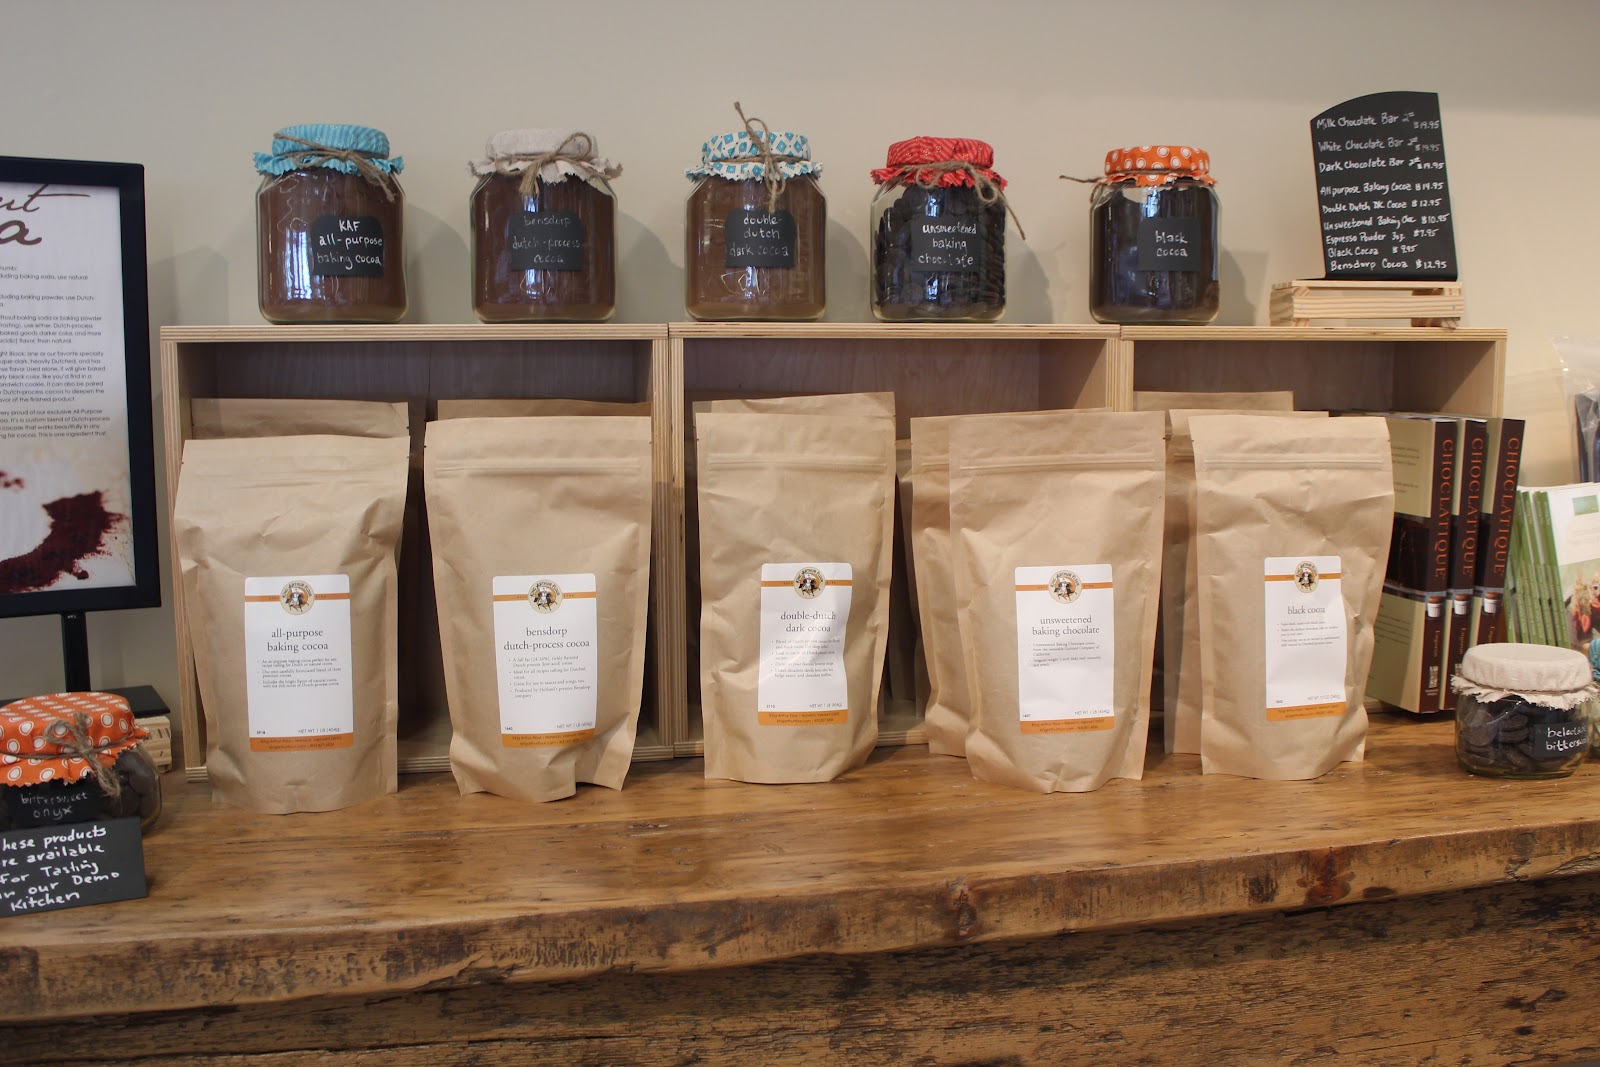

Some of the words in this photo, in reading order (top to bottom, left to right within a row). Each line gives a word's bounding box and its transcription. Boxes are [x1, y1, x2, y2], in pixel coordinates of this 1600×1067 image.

[1316, 118, 1336, 129] Milk
[1338, 115, 1377, 127] Chocolate
[1381, 112, 1399, 125] Bar
[1318, 141, 1342, 152] White
[1345, 138, 1385, 150] Chocolate
[1387, 137, 1403, 148] Bar
[1318, 161, 1343, 173] Dark
[1344, 157, 1386, 169] Chocolate
[1389, 157, 1404, 167] Bar
[1363, 182, 1389, 195] Baking
[1391, 182, 1412, 191] Cocoa
[1322, 203, 1347, 214] Double
[1349, 200, 1371, 211] Dutch
[1387, 200, 1407, 209] Cocoa
[339, 219, 360, 232] KAF
[523, 214, 571, 228] bensdorp
[1323, 217, 1373, 231] Unsweetened
[1377, 215, 1401, 229] Baking
[744, 227, 779, 239] dutch
[1155, 230, 1188, 243] black
[1326, 235, 1357, 246] Espresso
[1359, 231, 1386, 242] Powder
[729, 242, 754, 257] dark
[758, 245, 789, 256] cocoa
[932, 237, 968, 256] baking
[1156, 247, 1188, 257] cocoa
[1327, 247, 1353, 258] Black
[1355, 246, 1379, 256] Cocoa
[317, 251, 353, 270] baking
[355, 254, 382, 266] cocoa
[1330, 260, 1376, 272] Bensdorp
[1381, 258, 1408, 269] Cocoa
[1434, 438, 1454, 578] CHOCLATIQUE
[1461, 436, 1484, 576] CHOCLATIQUE
[1493, 436, 1521, 575] CHOCLATIQUE
[780, 610, 837, 620] double-dutch
[1287, 605, 1306, 615] black
[1040, 614, 1092, 625] unsweetened
[271, 628, 324, 640] all-purpose
[526, 626, 568, 638] bensdorp
[785, 623, 805, 632] dark
[1031, 626, 1060, 637] baking
[1062, 625, 1100, 635] chocolate
[267, 641, 299, 654] baking
[301, 643, 329, 651] cocoa
[503, 640, 564, 652] dutch-process
[566, 640, 590, 648] cocoa
[20, 791, 88, 805] bittersweet
[33, 805, 72, 820] onyx
[43, 825, 107, 849] products
[26, 843, 105, 863] available
[40, 860, 100, 877] Tasting
[28, 881, 60, 895] our
[71, 871, 120, 886] Demo
[10, 891, 80, 912] Kitchen
